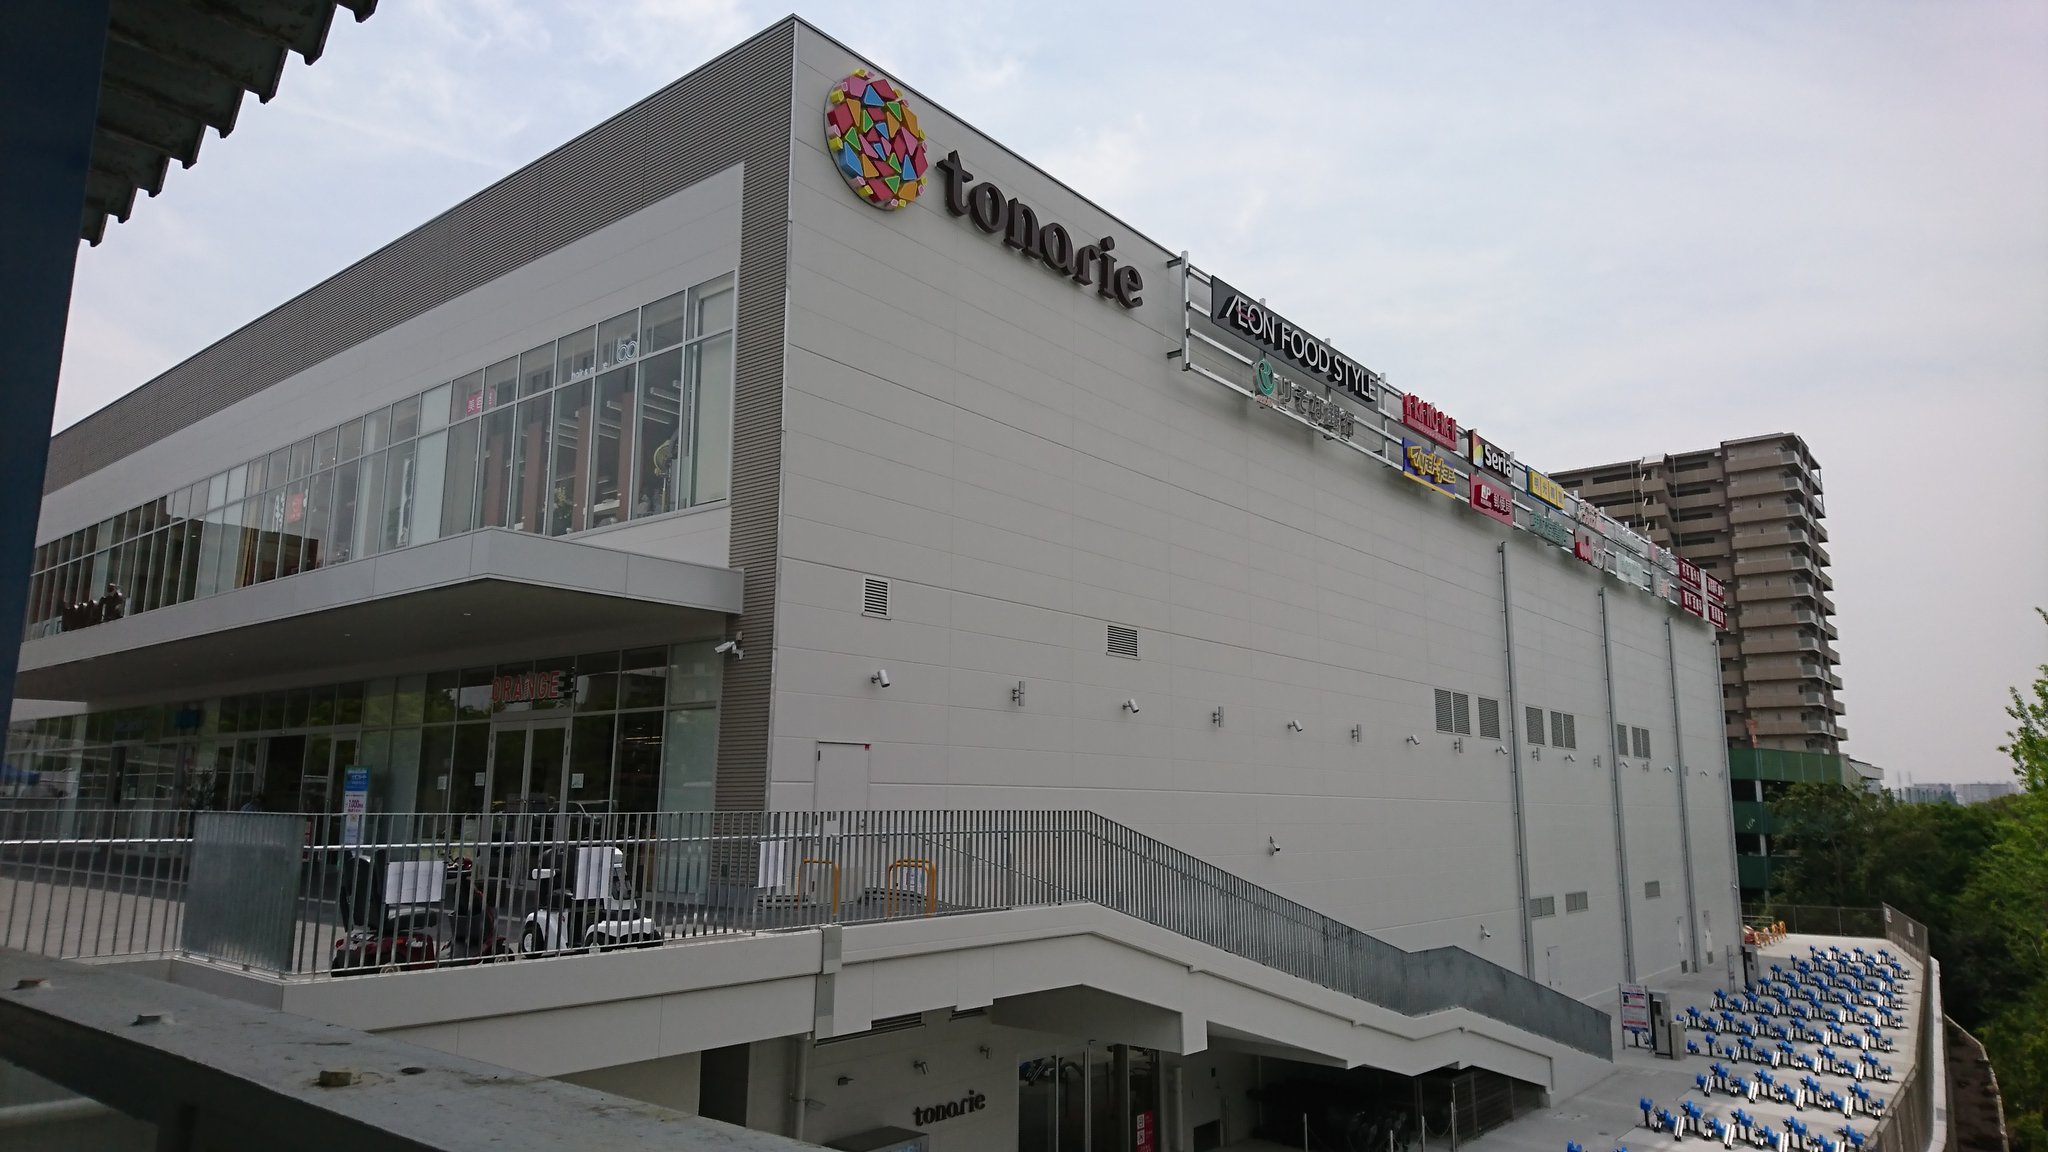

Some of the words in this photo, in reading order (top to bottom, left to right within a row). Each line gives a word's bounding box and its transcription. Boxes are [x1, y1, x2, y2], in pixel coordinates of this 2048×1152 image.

[935, 150, 1144, 309] tonarie
[1279, 322, 1330, 373] FOOD
[1332, 354, 1377, 402] STYLE
[1277, 376, 1355, 440] りそな銀行
[1408, 446, 1456, 484] マツモトキヨシ
[1484, 444, 1512, 478] Seria
[492, 671, 562, 703] ORANGE
[913, 1090, 985, 1127] tonarie
